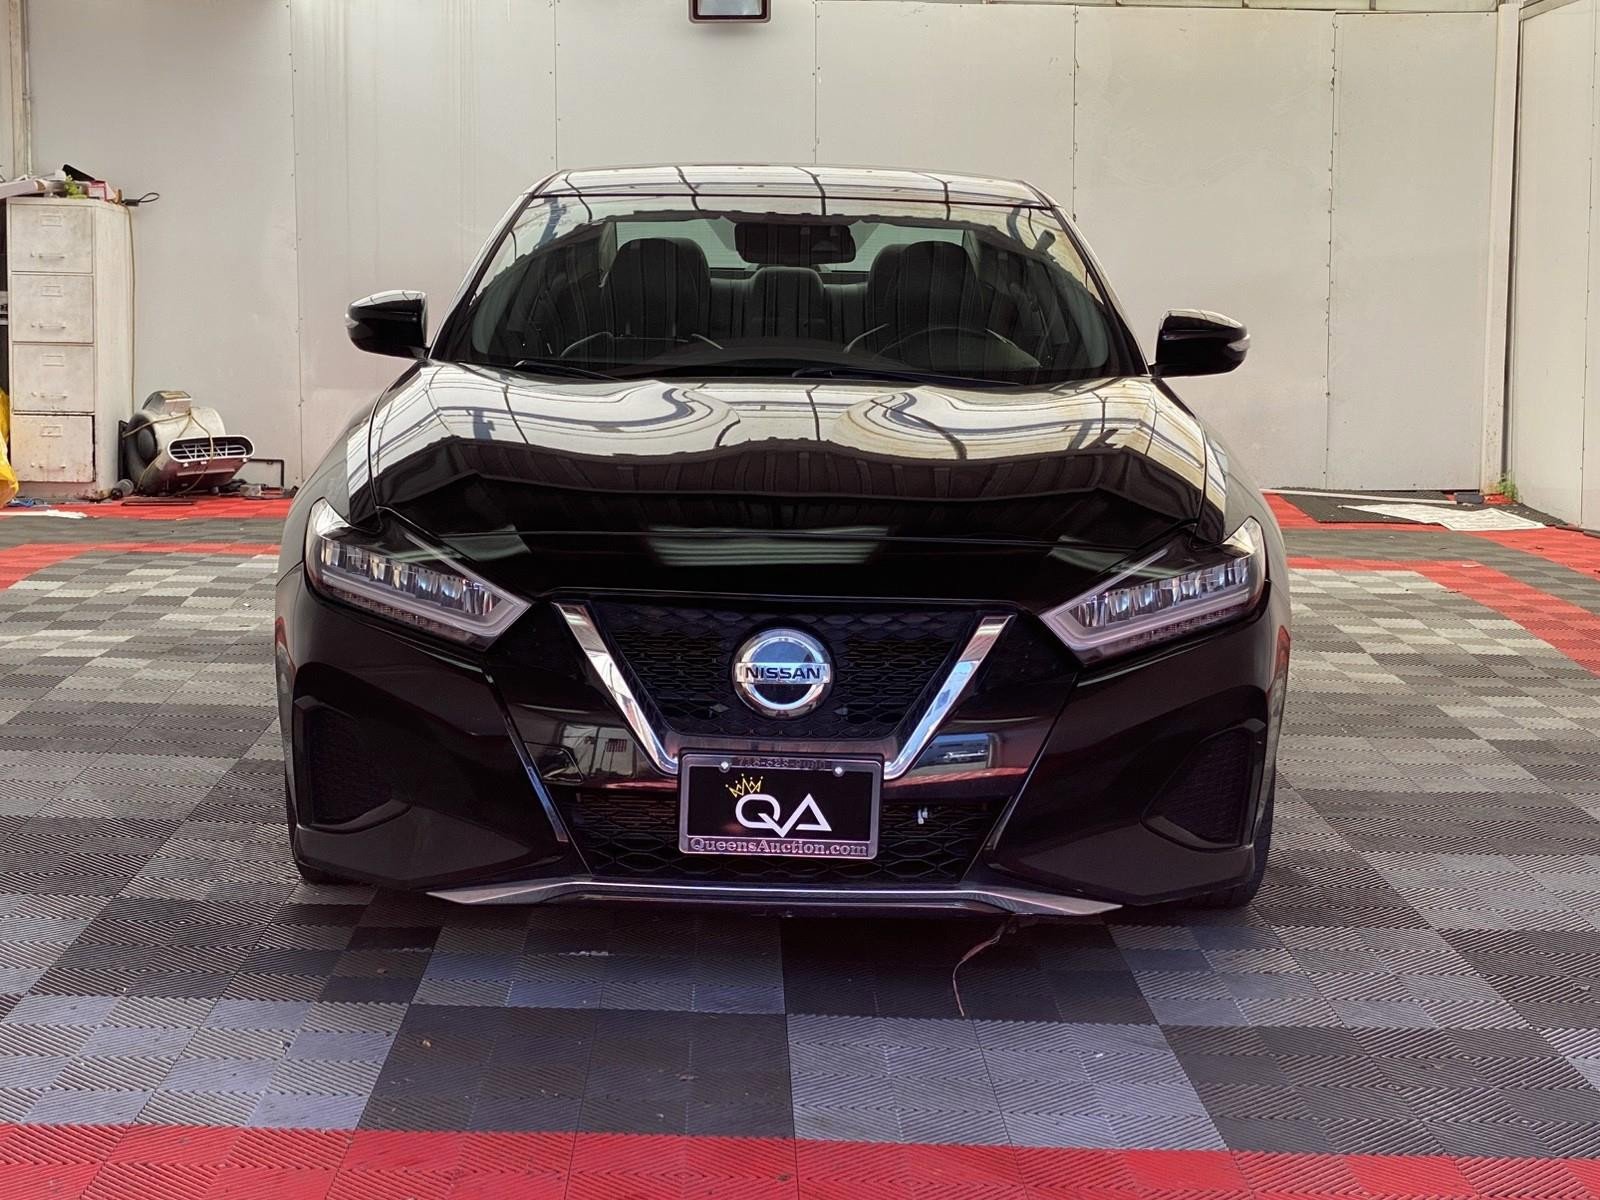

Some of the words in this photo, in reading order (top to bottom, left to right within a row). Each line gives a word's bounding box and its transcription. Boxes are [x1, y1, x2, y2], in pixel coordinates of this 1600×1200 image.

[745, 667, 820, 679] NISSAN
[735, 793, 832, 838] QA
[689, 837, 867, 856] QueensAuction.com
